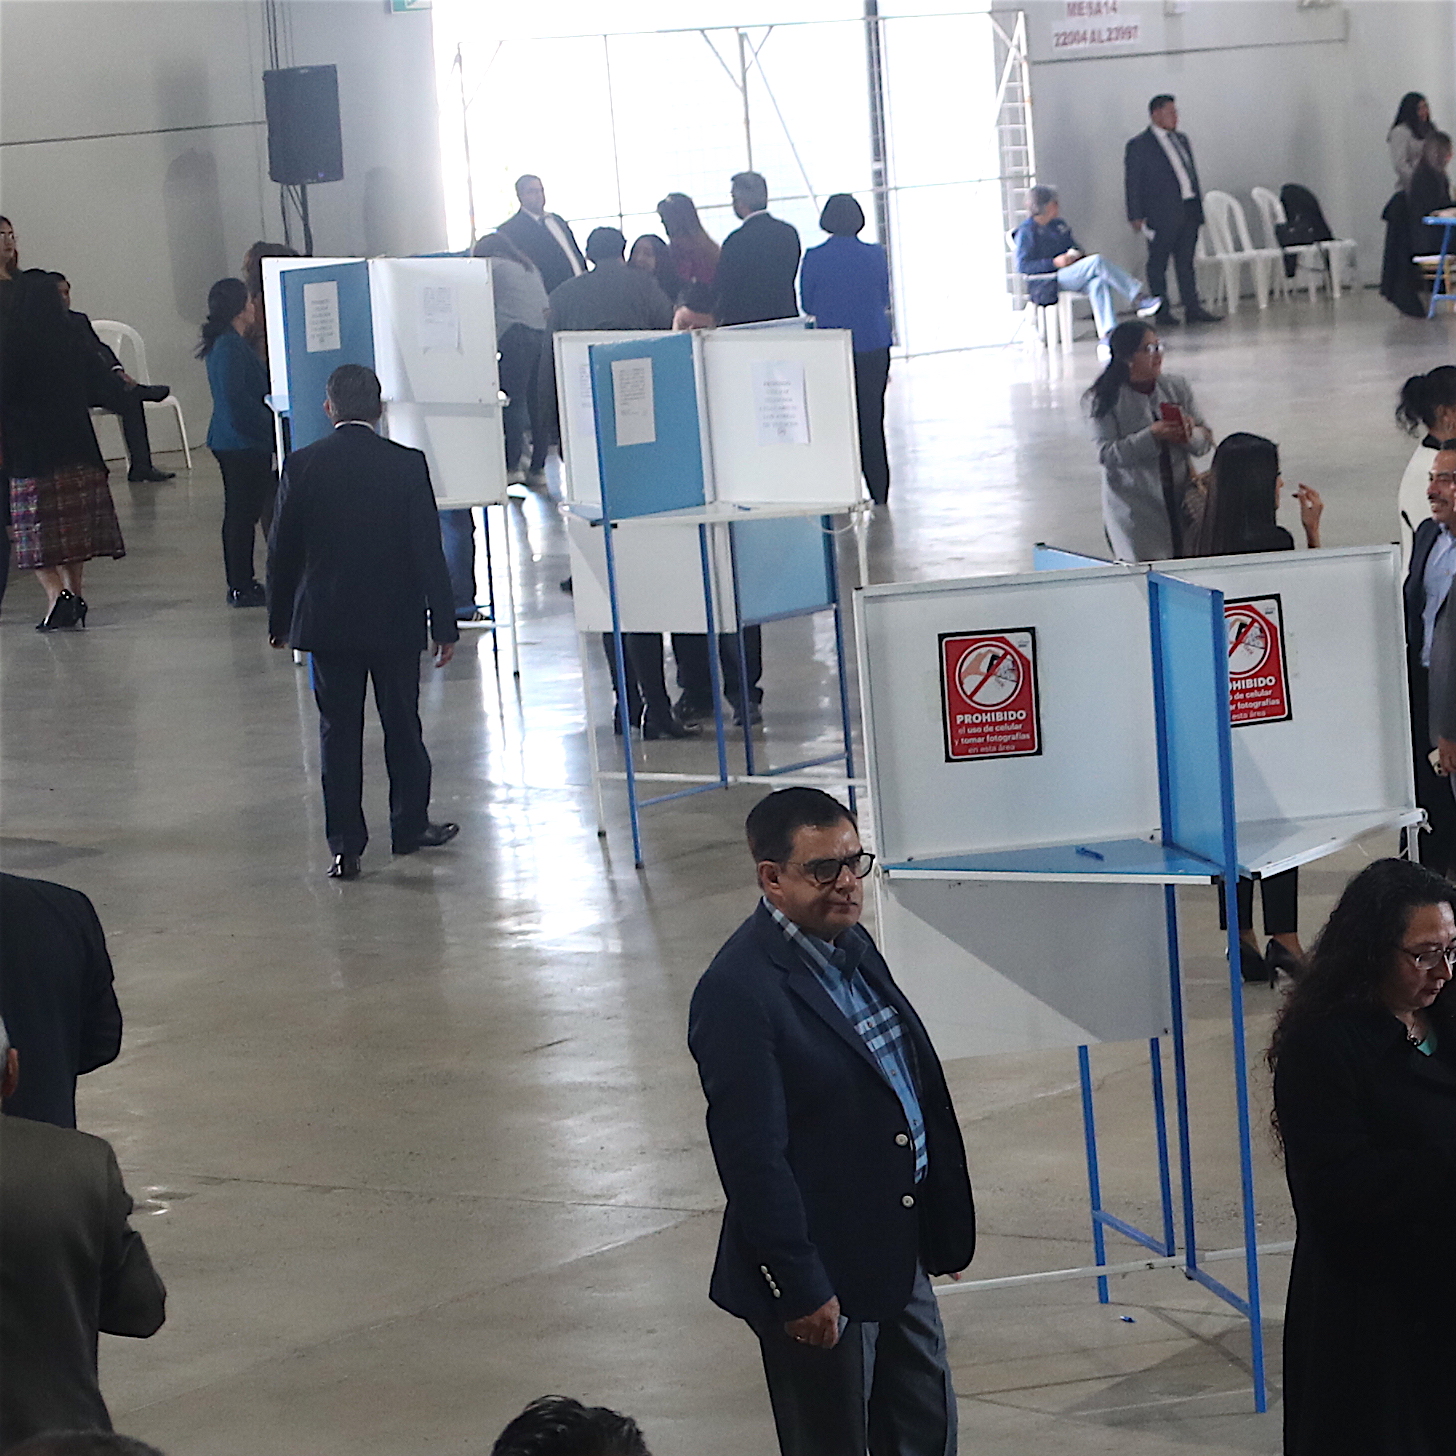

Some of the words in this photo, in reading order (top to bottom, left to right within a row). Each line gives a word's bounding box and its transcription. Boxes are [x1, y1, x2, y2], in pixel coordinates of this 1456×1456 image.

[1230, 676, 1276, 690] HIBIDO
[1245, 689, 1273, 698] celular
[956, 710, 1027, 724] PROHIBIDO
[967, 726, 982, 734] uso
[983, 724, 994, 732] de
[995, 722, 1023, 732] celular
[961, 736, 985, 744] tomar
[968, 746, 979, 754] en
[980, 744, 997, 753] esta
